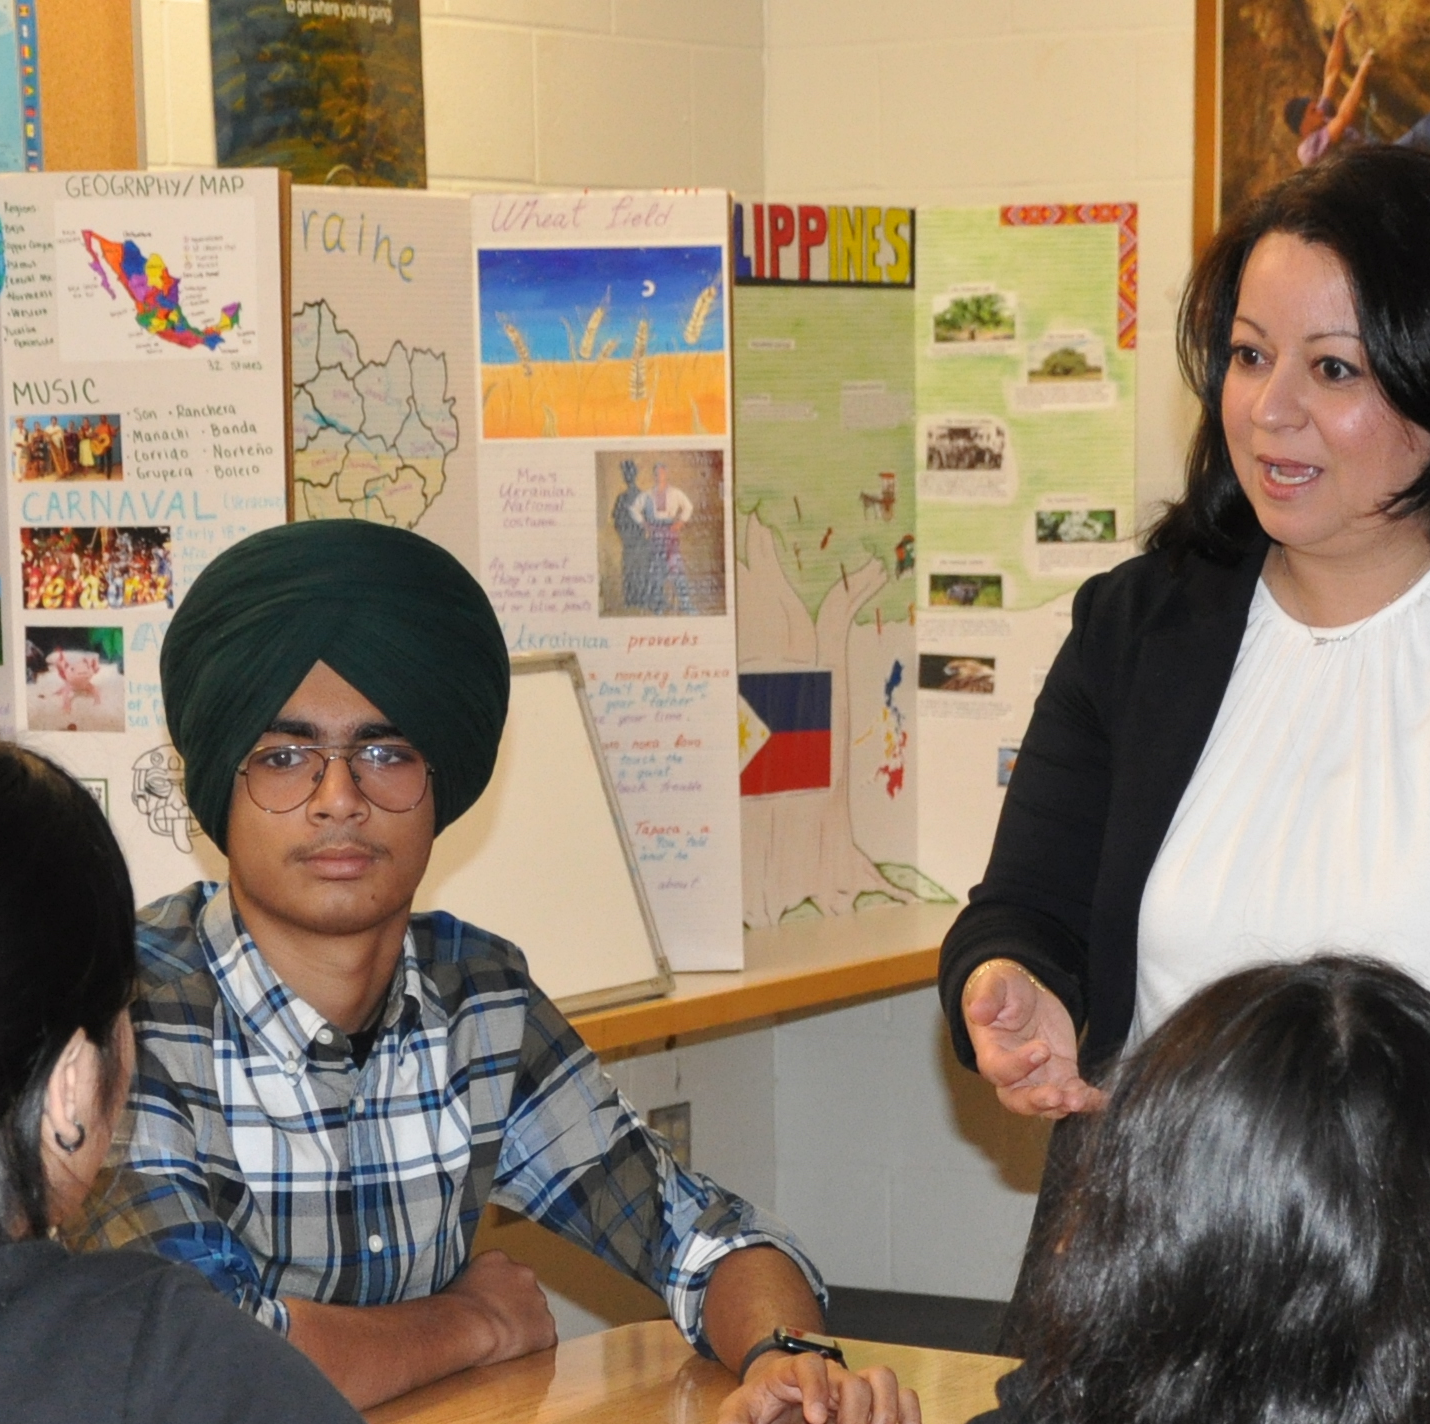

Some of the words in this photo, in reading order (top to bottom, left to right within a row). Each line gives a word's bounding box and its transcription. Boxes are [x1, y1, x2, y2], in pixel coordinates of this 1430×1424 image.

[297, 0, 312, 18] get
[313, 0, 341, 17] where
[200, 174, 244, 196] MAP
[491, 197, 582, 233] Wheat
[734, 203, 911, 284] LIPPINES
[12, 378, 100, 406] MUSIC
[133, 408, 158, 422] Son
[176, 404, 237, 419] Ranchera
[210, 421, 258, 437] Banda
[213, 443, 274, 463] Norteño
[136, 465, 193, 481] Grupera
[214, 464, 260, 480] Bolero
[21, 489, 218, 523] CARNAVAL
[544, 576, 552, 584] a
[627, 631, 699, 653] proverbs
